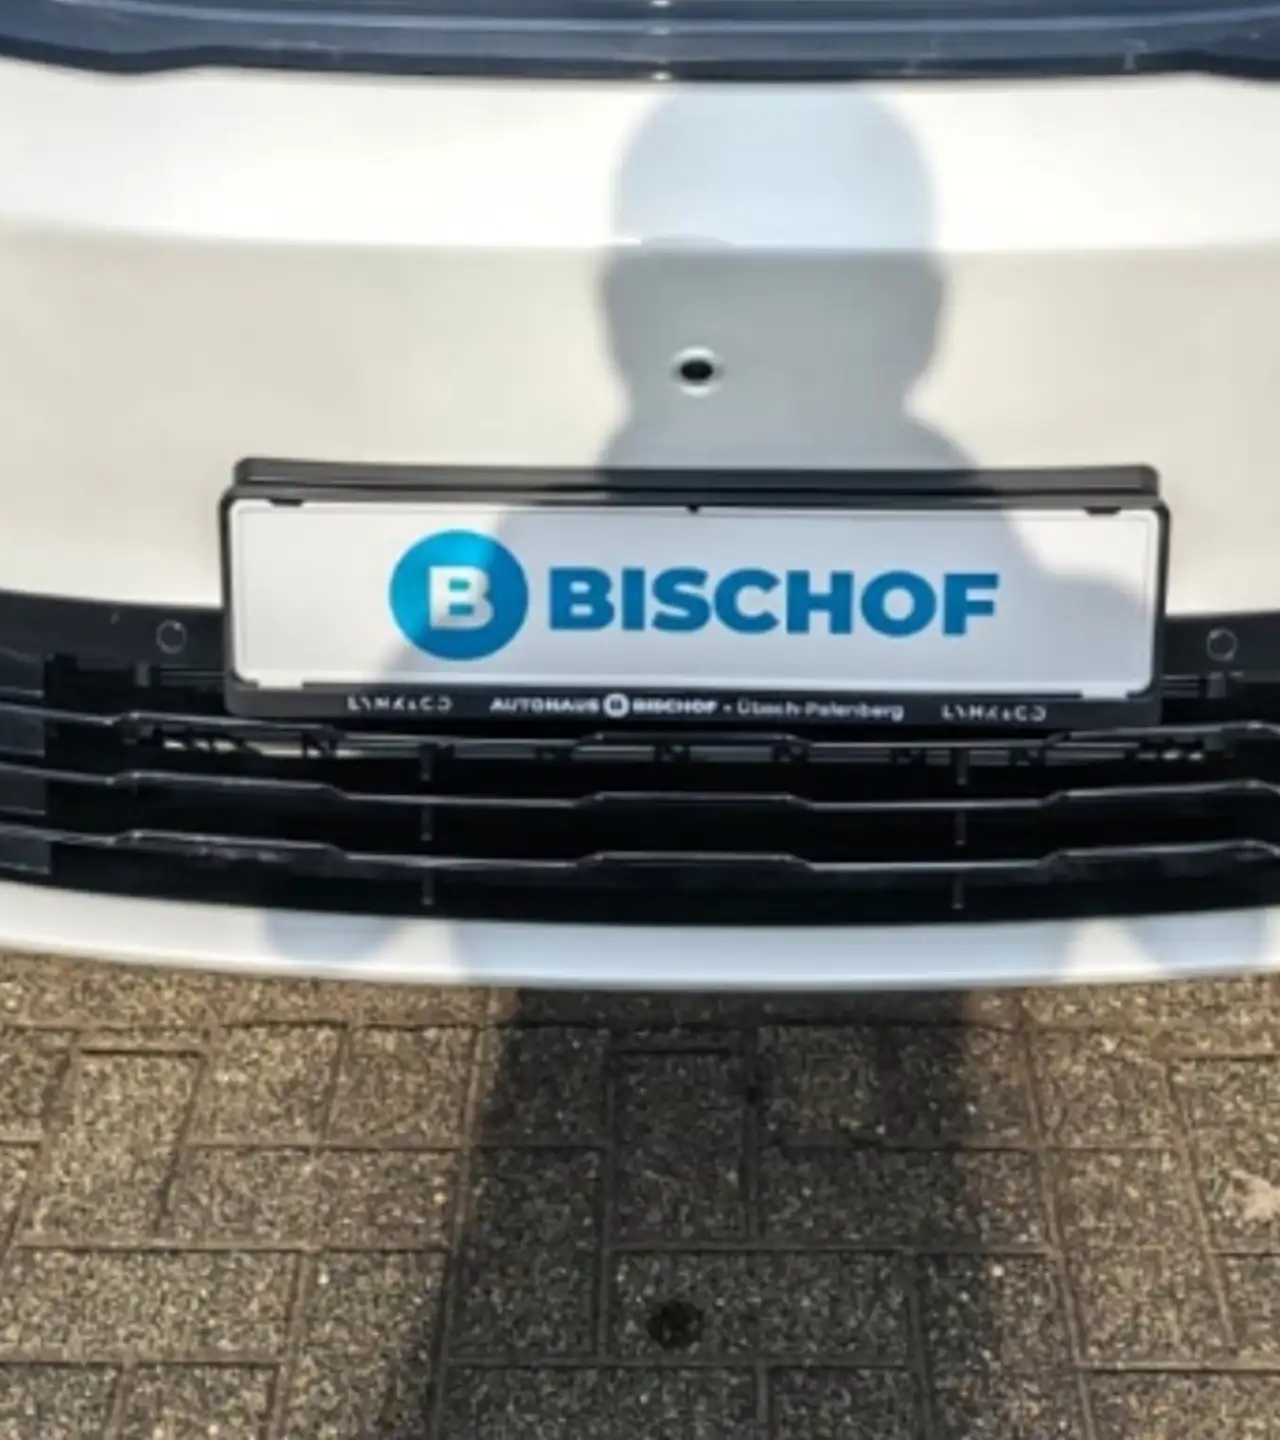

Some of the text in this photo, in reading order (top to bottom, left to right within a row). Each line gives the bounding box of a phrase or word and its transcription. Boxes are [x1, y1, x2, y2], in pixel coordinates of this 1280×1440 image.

[428, 565, 1000, 639] B BISCHOF
[489, 696, 600, 714] AUTOHAUS
[632, 697, 718, 715] BISCHOF
